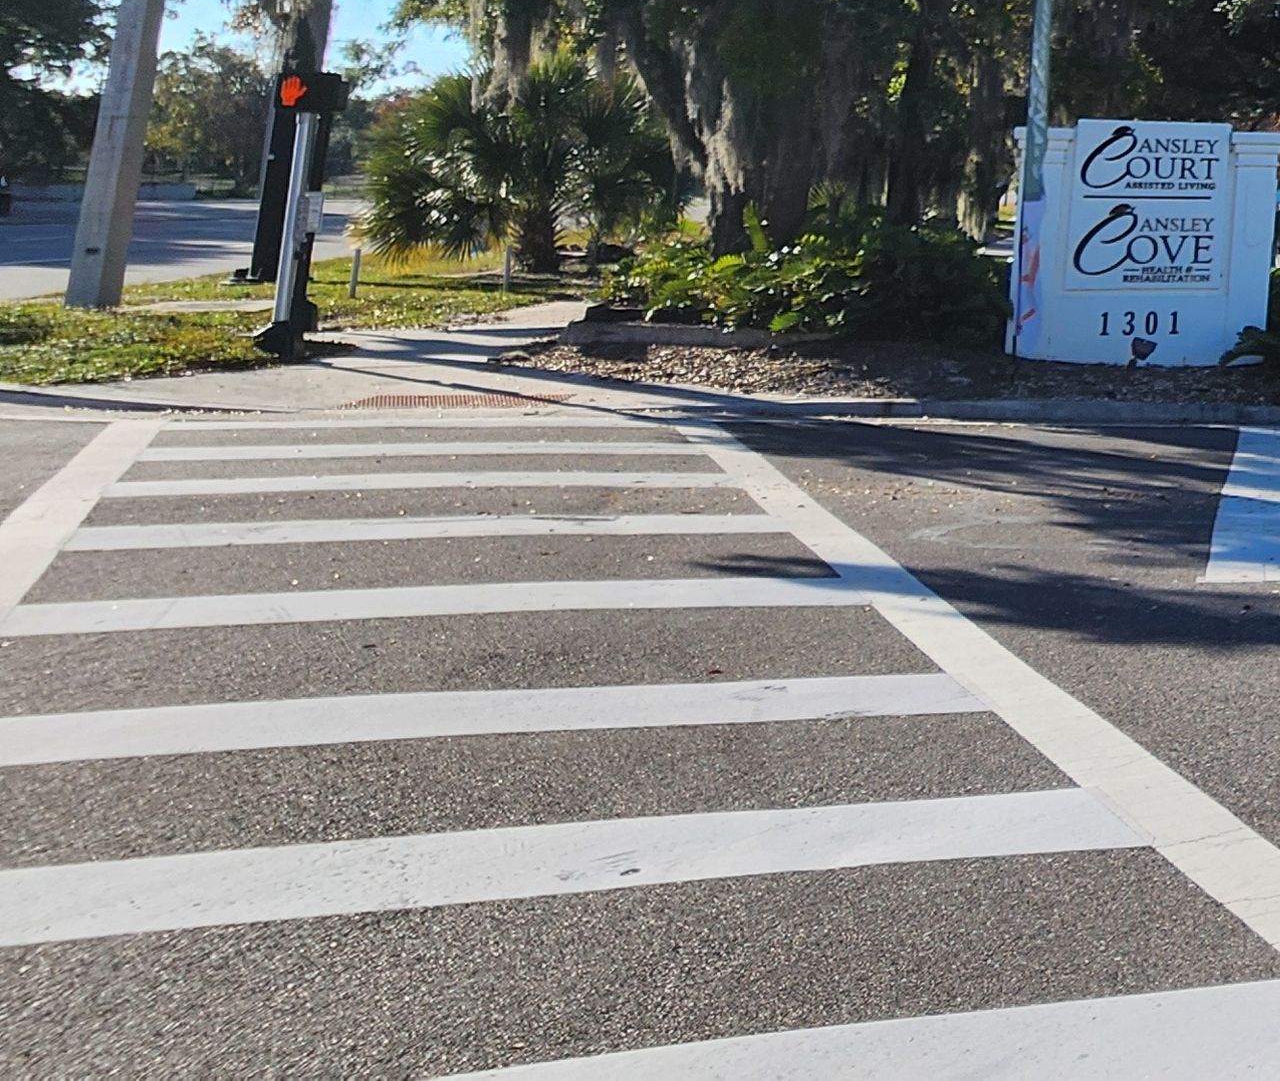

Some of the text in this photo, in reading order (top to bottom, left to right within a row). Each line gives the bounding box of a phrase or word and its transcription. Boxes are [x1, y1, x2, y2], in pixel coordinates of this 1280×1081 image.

[1138, 138, 1219, 154] ANSLEY
[1081, 131, 1220, 188] COURT
[1124, 181, 1216, 190] ASSISTED LIVING
[1139, 218, 1215, 232] ANSLEY
[1073, 209, 1214, 275] COVE
[1142, 266, 1182, 274] HEALTH
[1122, 274, 1210, 283] REHABILITATION
[1099, 310, 1180, 336] 1301
